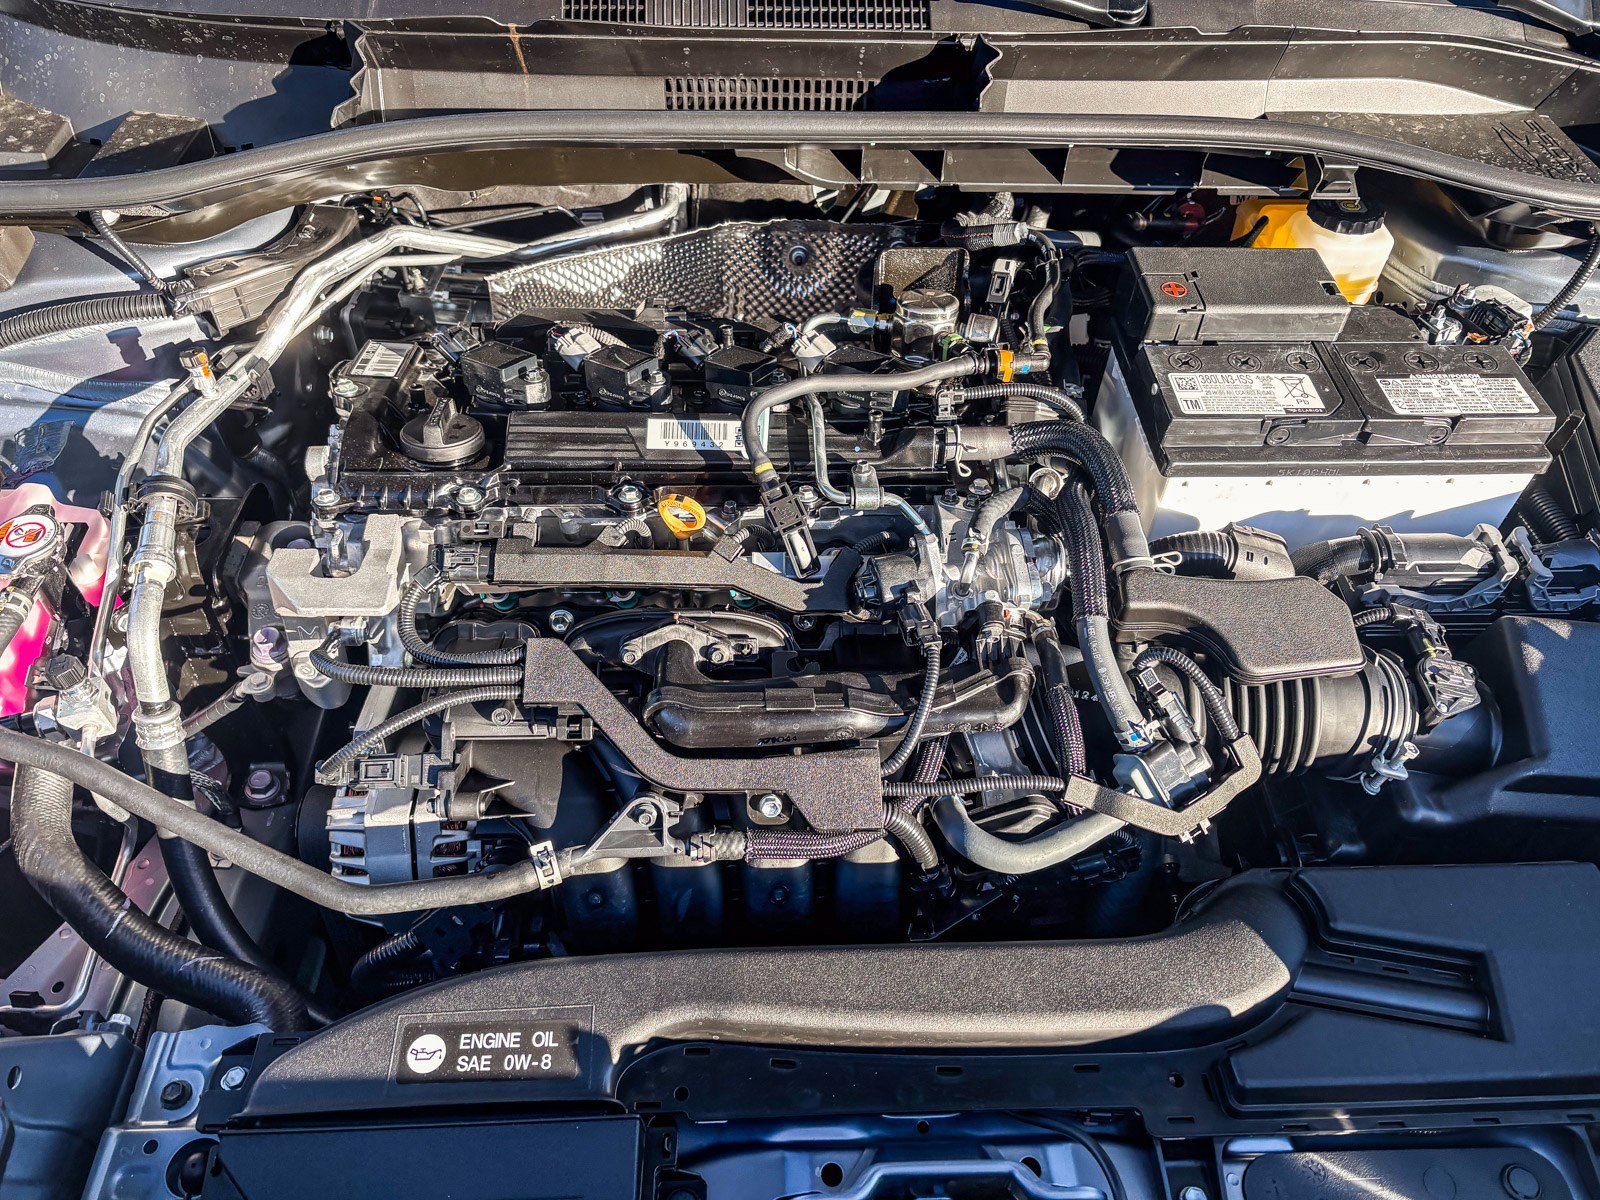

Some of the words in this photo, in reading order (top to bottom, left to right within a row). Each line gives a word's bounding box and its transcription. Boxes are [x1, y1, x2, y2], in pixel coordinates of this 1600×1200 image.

[1182, 399, 1201, 410] TM
[664, 440, 725, 448] Y969432
[459, 1032, 521, 1049] ENGINE
[531, 1031, 559, 1048] OIL
[456, 1055, 492, 1072] SAE
[503, 1053, 552, 1071] 0W-8
